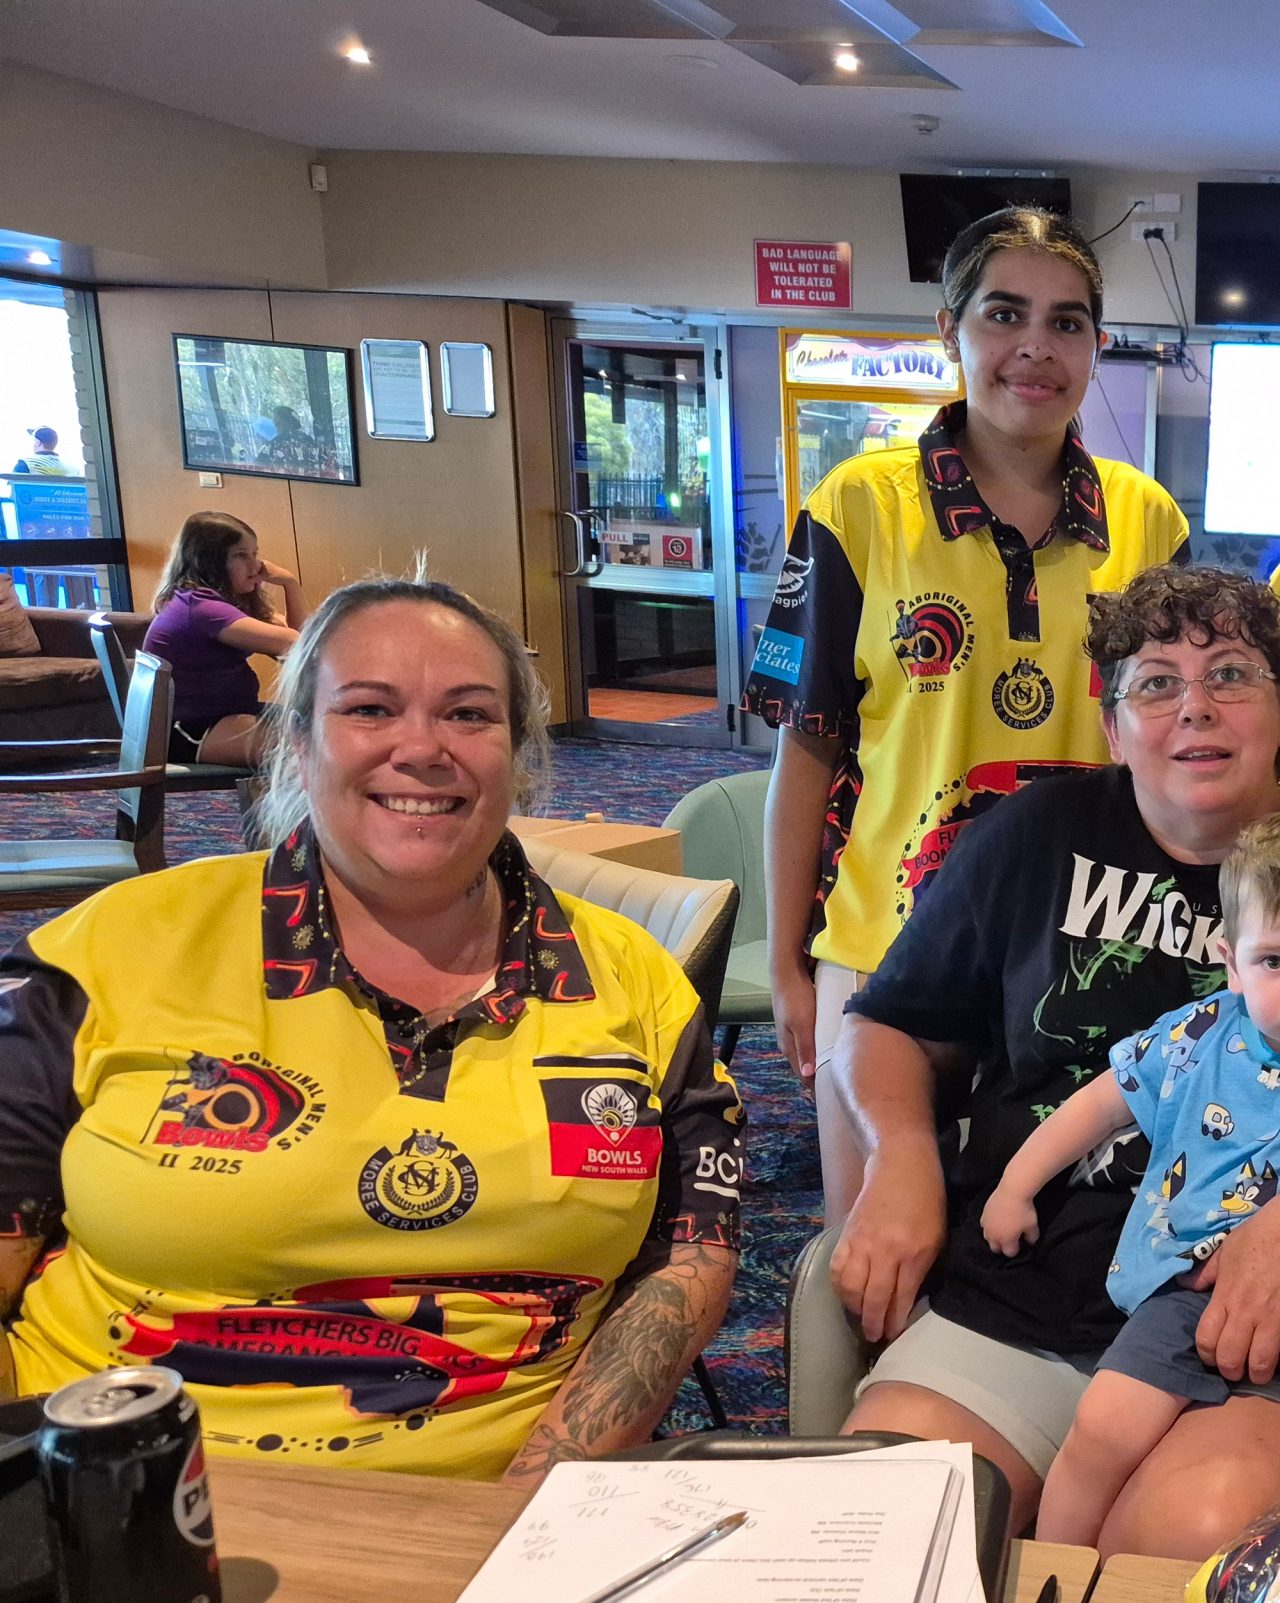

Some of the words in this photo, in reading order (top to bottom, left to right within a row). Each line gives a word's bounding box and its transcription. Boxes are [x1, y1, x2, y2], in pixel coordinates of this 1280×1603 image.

[762, 248, 784, 259] BAD
[787, 249, 843, 261] LANGUAGE
[769, 261, 795, 273] WILL
[798, 263, 819, 273] NOT
[822, 264, 837, 274] BE
[773, 275, 833, 288] TOLERATED
[771, 289, 782, 300] IN
[785, 289, 806, 300] THE
[808, 290, 836, 302] CLUB
[851, 350, 947, 380] FACTORY
[602, 532, 628, 543] PULL
[908, 592, 974, 628] ABORIGINAL
[761, 640, 791, 656] ner
[755, 651, 800, 674] ciates
[918, 681, 945, 693] 2025
[1002, 710, 1049, 730] SERVICES
[1058, 852, 1227, 965] WICK
[232, 1051, 324, 1098] BORIGINAL
[190, 1155, 243, 1175] 2025
[587, 1148, 642, 1165] BOWLS
[582, 1164, 598, 1173] NEW
[600, 1165, 626, 1174] SOUTH
[627, 1166, 647, 1174] WALES
[360, 1158, 384, 1211] MOREE
[377, 1205, 464, 1230] SERVICES
[460, 1164, 477, 1202] CLUB
[216, 1316, 370, 1347] FLETCHERS
[375, 1327, 421, 1357] BIG
